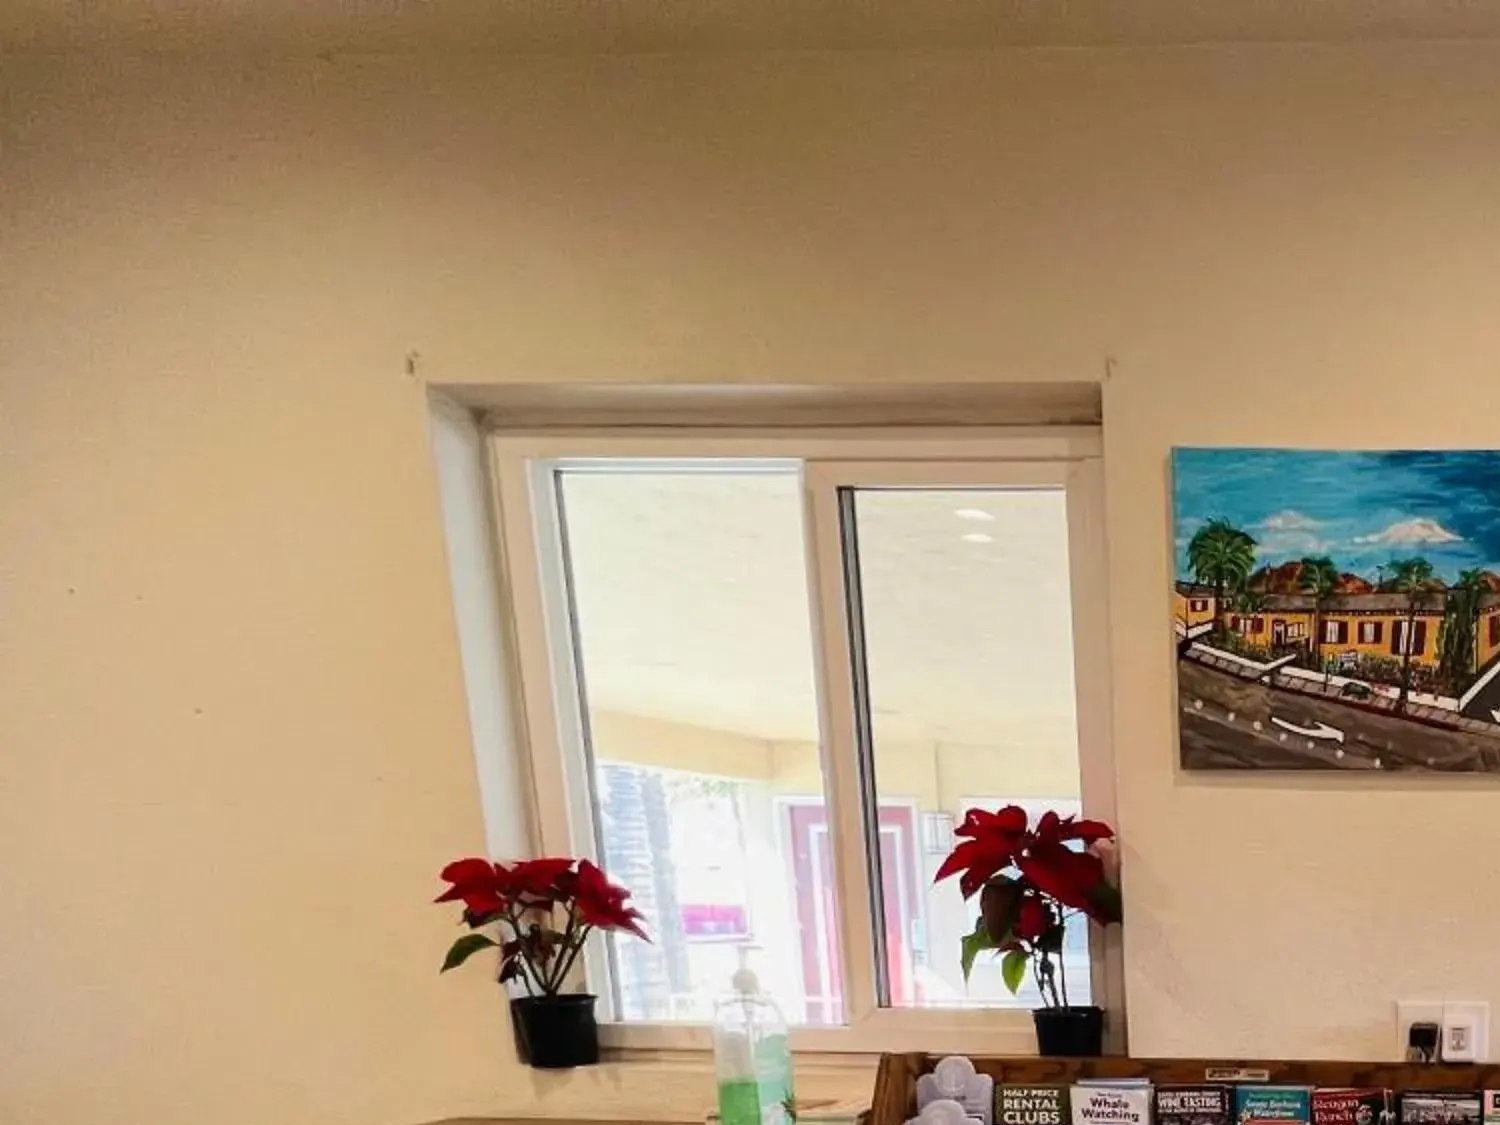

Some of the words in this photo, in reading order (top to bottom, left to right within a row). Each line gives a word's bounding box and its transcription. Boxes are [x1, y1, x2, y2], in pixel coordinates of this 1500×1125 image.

[1003, 1089, 1029, 1098] HALF
[1031, 1089, 1060, 1098] PRICE
[1003, 1098, 1061, 1110] RENTAL
[1090, 1097, 1130, 1109] Whale
[1184, 1097, 1222, 1108] TASTING
[1003, 1111, 1061, 1125] CLUBS
[1081, 1108, 1140, 1122] Watching
